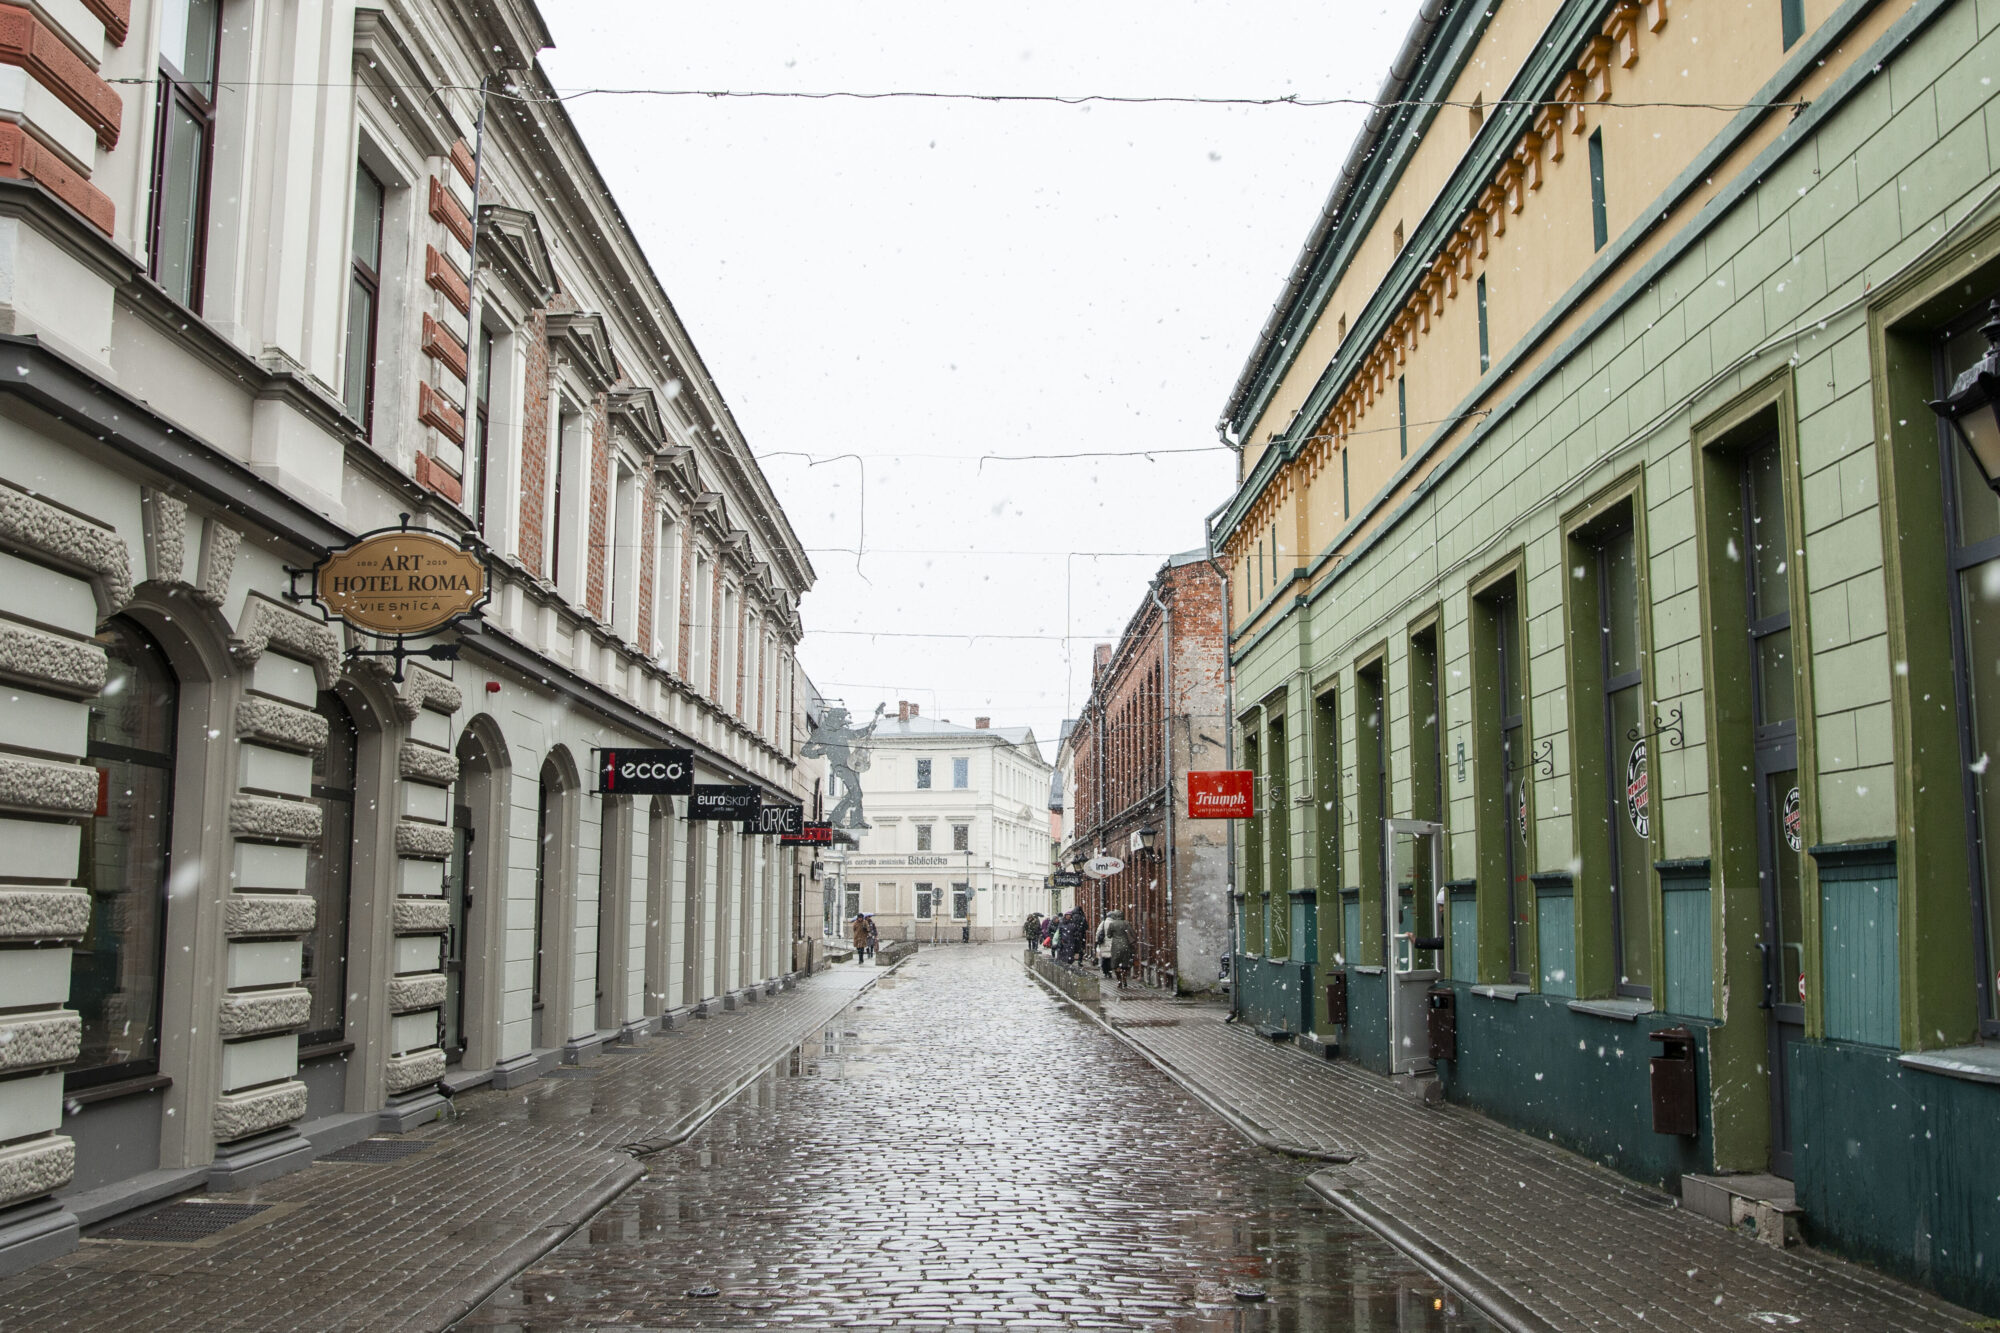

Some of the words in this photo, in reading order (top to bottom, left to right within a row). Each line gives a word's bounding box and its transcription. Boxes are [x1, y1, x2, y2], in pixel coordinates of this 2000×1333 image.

[380, 554, 424, 571] ART
[333, 575, 403, 593] HOTEL
[408, 574, 472, 592] ROMA
[359, 600, 441, 611] VIESNĪCA
[621, 762, 683, 780] ecco
[697, 793, 751, 807] euroskor
[1195, 791, 1245, 807] Triumph
